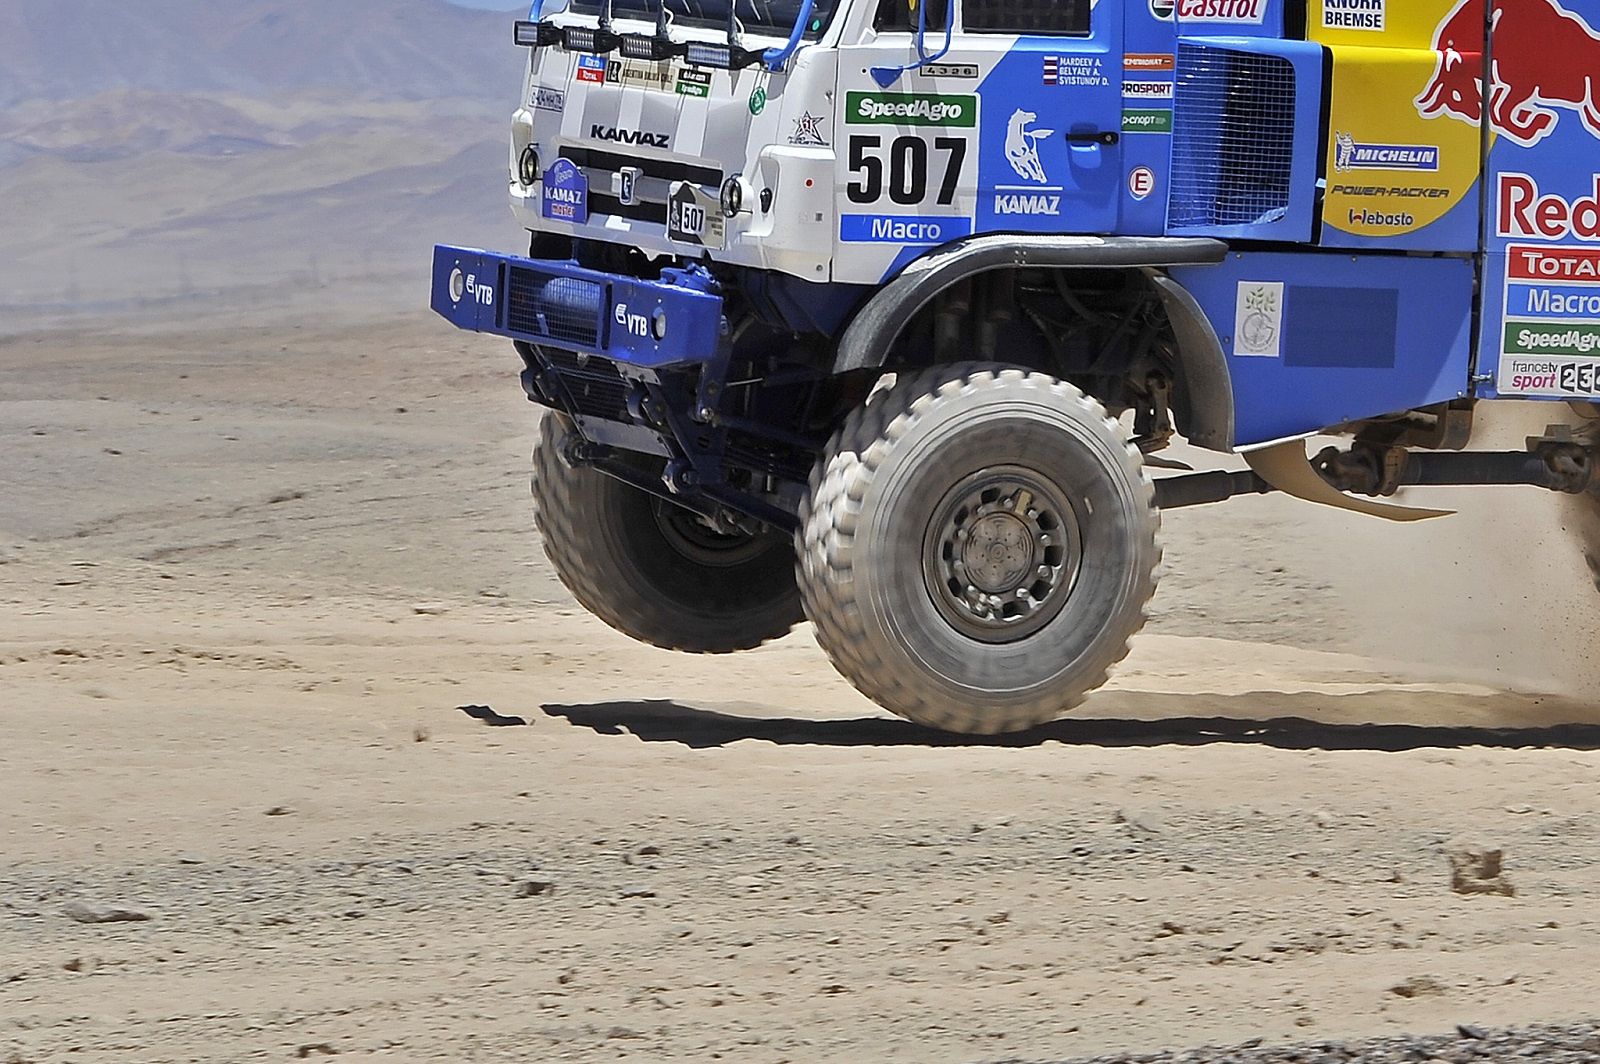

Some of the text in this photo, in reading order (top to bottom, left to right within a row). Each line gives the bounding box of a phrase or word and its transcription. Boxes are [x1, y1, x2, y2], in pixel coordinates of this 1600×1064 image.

[1325, 10, 1382, 29] BREMSE
[857, 98, 963, 121] SpeedAgro
[590, 124, 671, 149] KAMAZ
[1354, 148, 1436, 164] MICHELIN
[846, 135, 967, 205] 507
[1134, 172, 1148, 192] E
[545, 186, 582, 204] KAMAZ
[994, 194, 1061, 215] KAMAZ
[683, 207, 704, 232] 507
[1348, 207, 1414, 227] Webasto
[871, 219, 942, 240] Macro
[474, 283, 493, 306] VTB
[627, 313, 648, 336] VTB
[1511, 373, 1557, 391] sport
